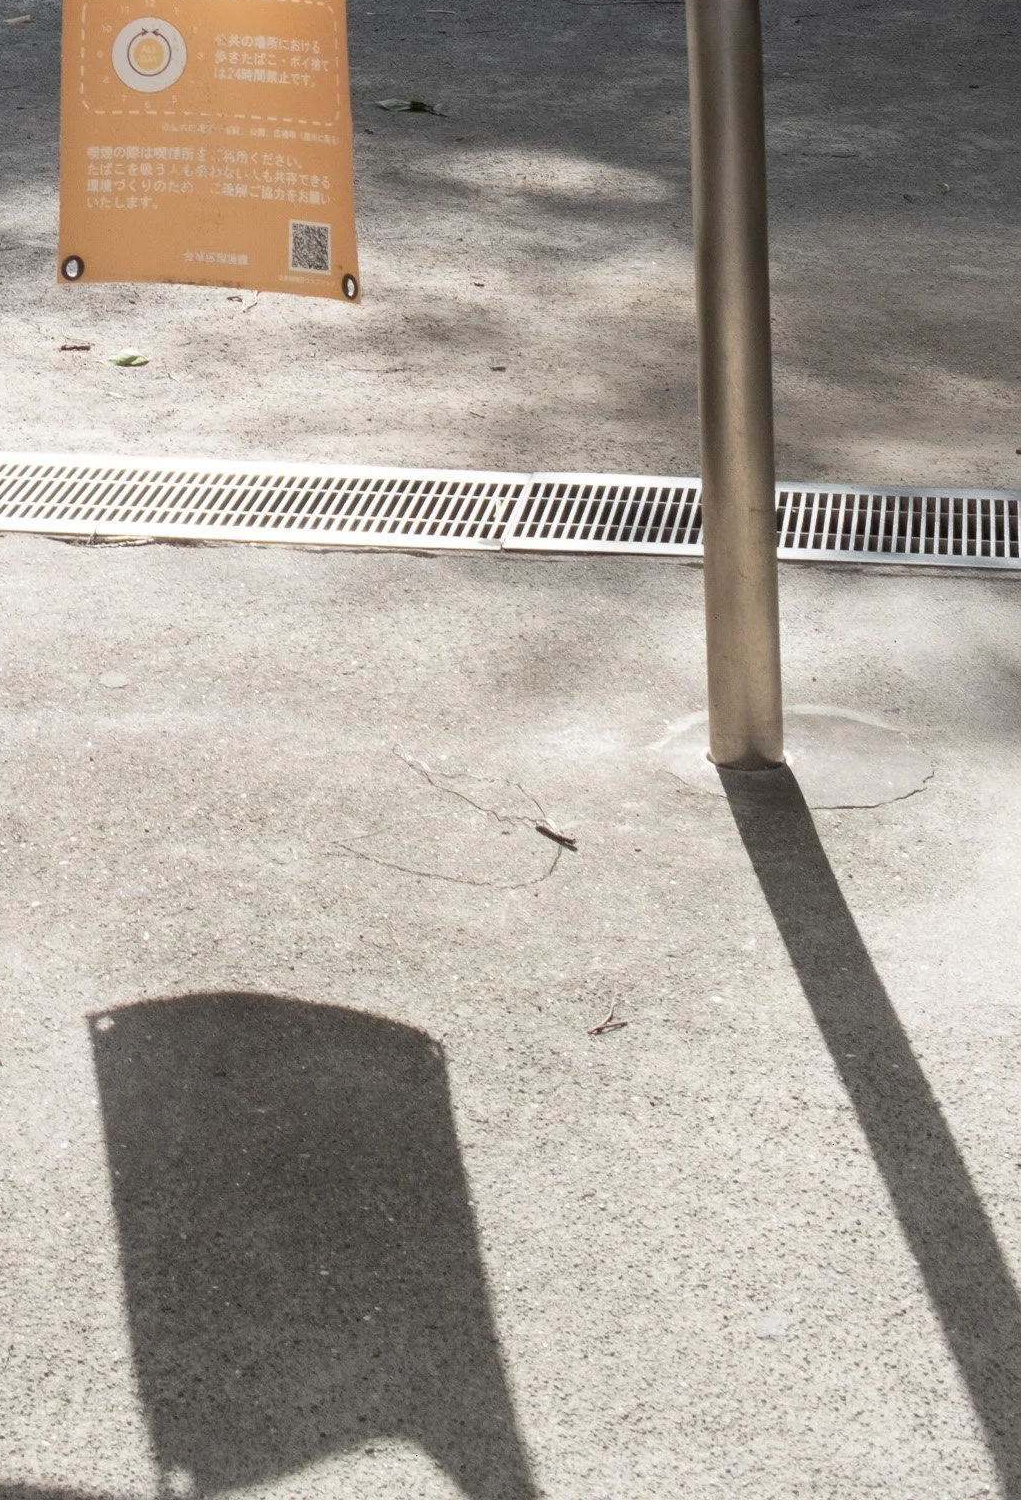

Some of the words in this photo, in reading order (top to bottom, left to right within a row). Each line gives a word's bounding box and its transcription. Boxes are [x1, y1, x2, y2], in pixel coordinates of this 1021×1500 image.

[214, 34, 320, 54] 公共の場所における
[214, 50, 331, 72] 歩きたばこ・ポイ捨て
[86, 179, 331, 205] 環境づくりのためご理解ご協力をお願い
[87, 195, 159, 210] いたします。
